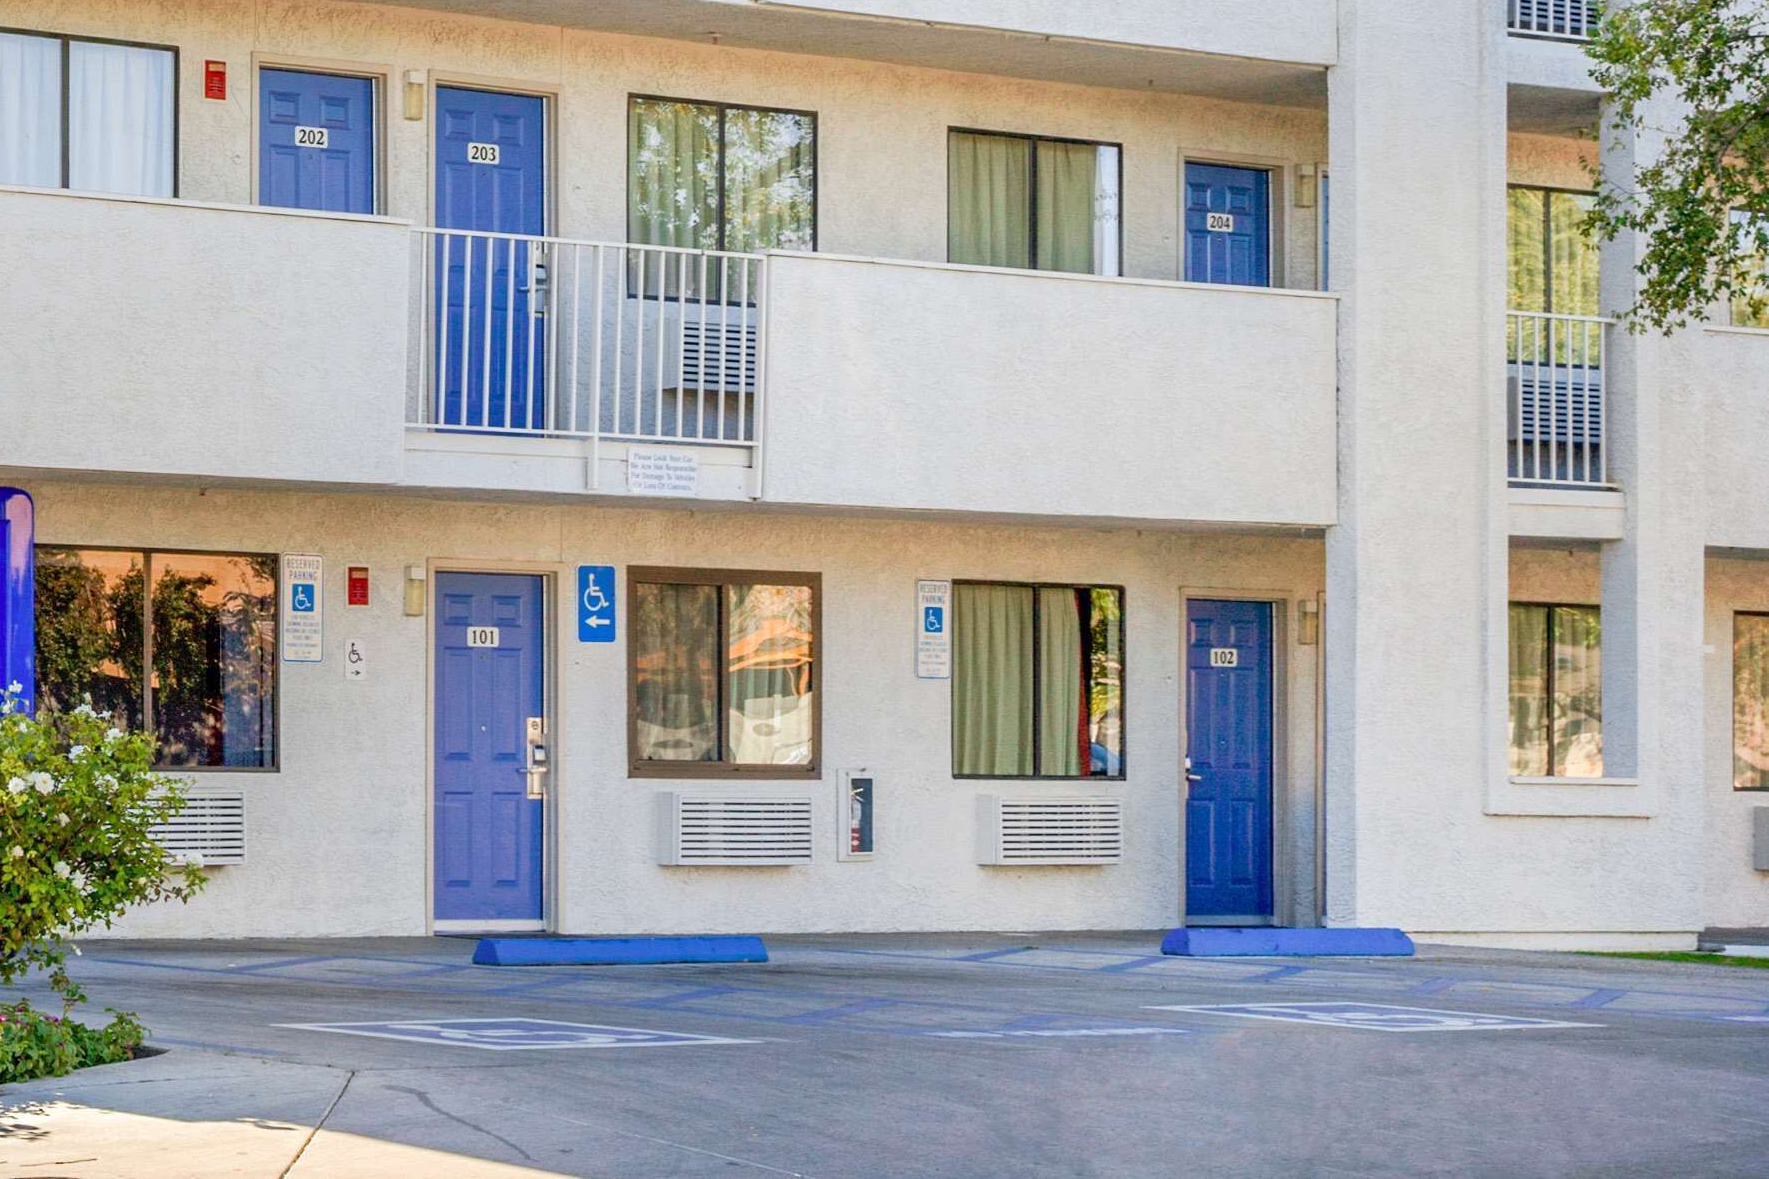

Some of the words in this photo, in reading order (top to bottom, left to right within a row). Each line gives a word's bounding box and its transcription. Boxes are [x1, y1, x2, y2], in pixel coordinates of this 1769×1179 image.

[299, 129, 324, 145] 202
[471, 145, 496, 161] 203
[1209, 215, 1230, 229] 204
[286, 557, 320, 570] RESERVED
[288, 569, 318, 580] PARKING
[473, 629, 494, 644] 101
[1214, 651, 1234, 664] 102
